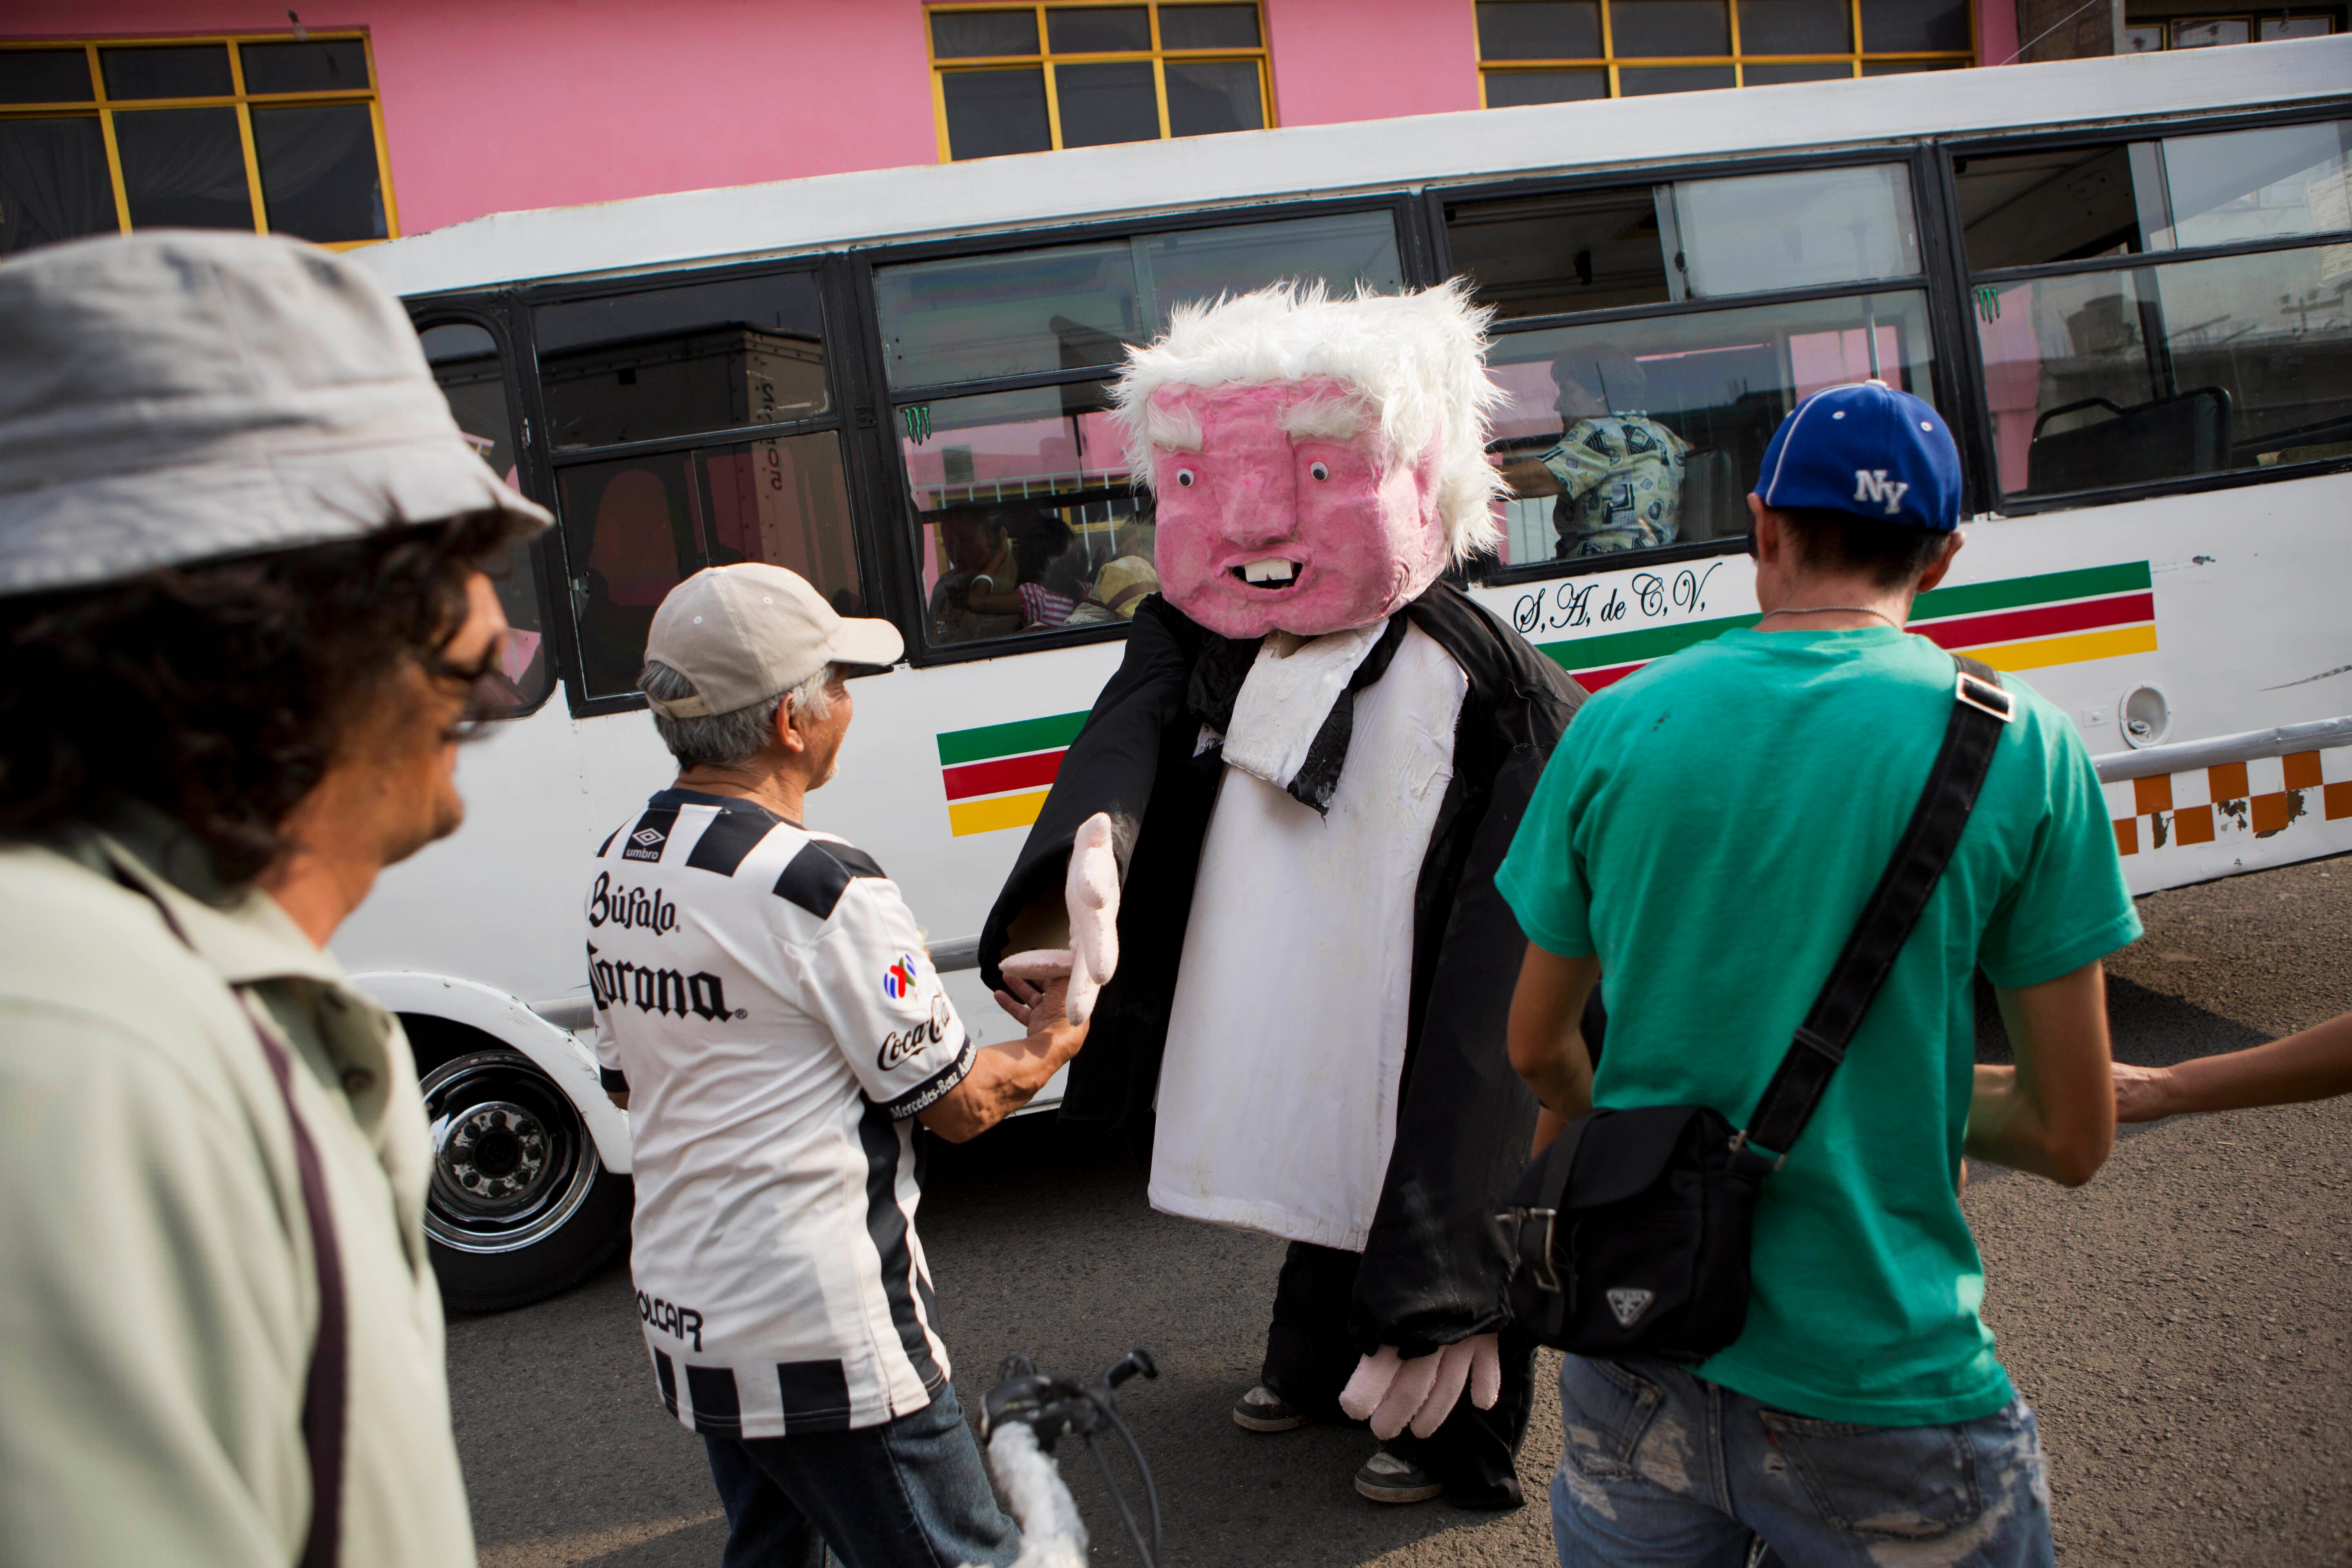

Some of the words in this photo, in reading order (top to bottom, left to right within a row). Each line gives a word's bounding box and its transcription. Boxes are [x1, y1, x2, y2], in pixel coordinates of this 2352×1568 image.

[1854, 470, 1909, 514] NY
[1601, 588, 1626, 621] de
[626, 848, 659, 860] umbro
[589, 871, 676, 936] Búfalo
[889, 1071, 960, 1119] Mercedes-Benz
[634, 1286, 704, 1352] OLCAR
